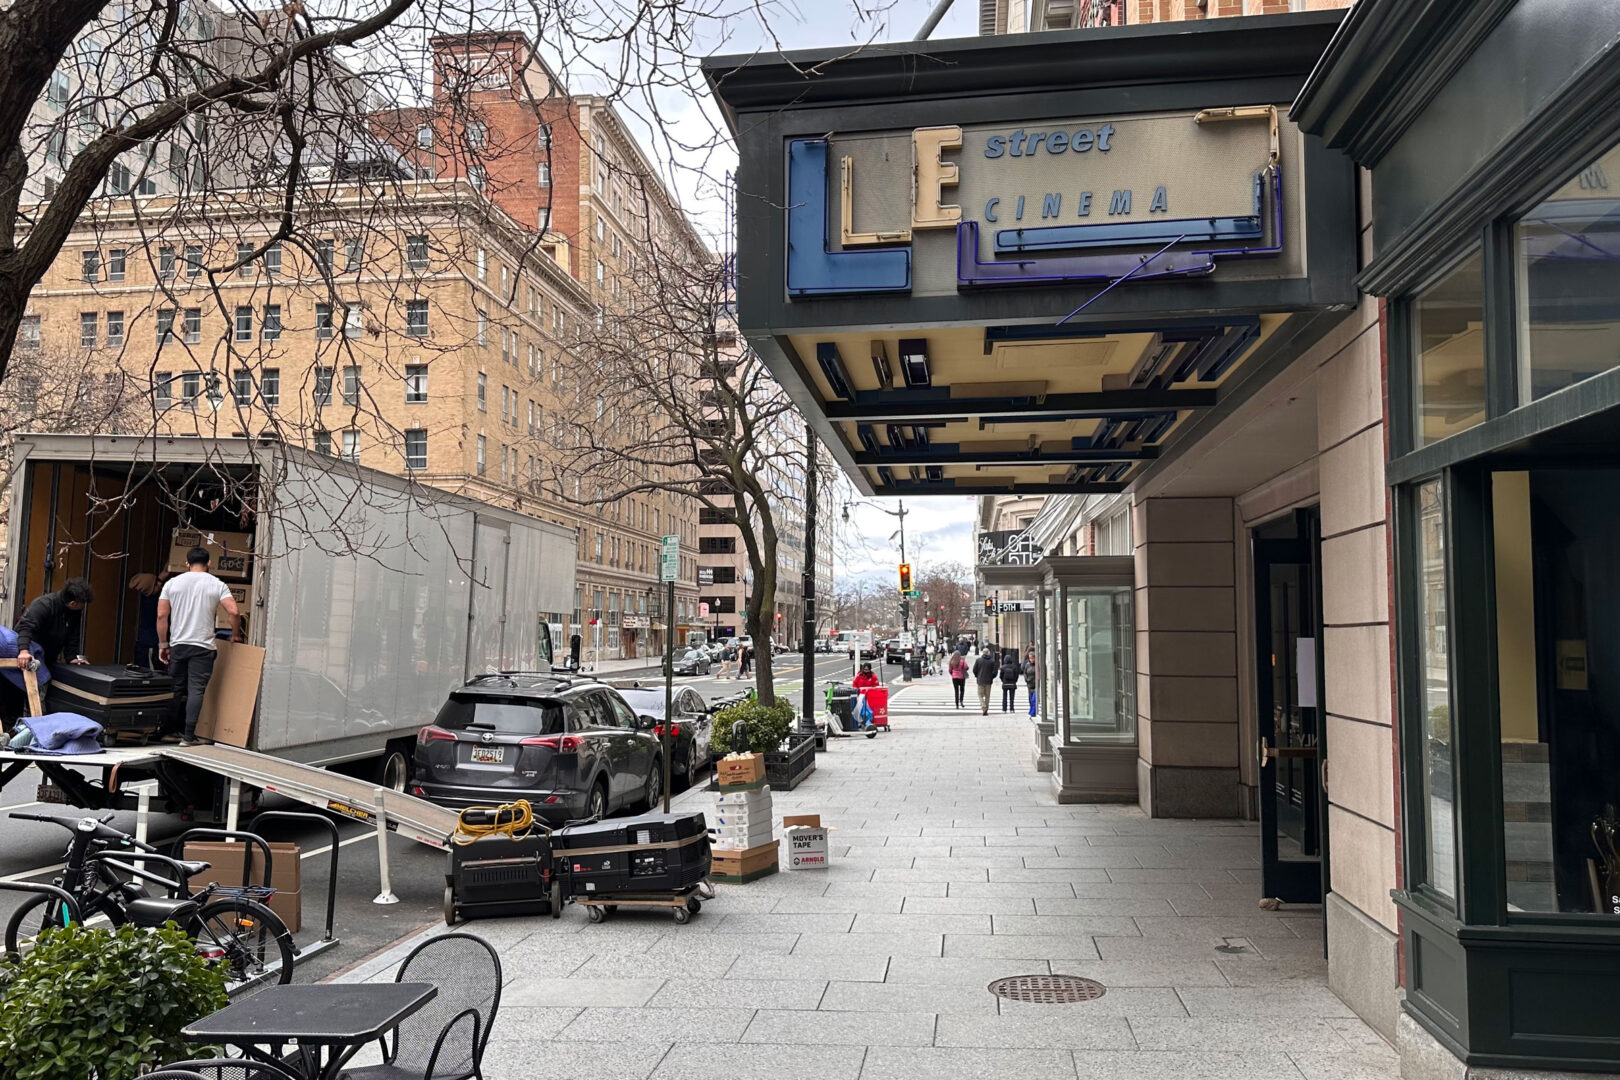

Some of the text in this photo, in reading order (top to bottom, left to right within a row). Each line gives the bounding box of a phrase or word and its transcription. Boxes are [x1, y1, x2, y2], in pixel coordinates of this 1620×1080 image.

[984, 123, 1115, 158] street
[985, 186, 1168, 222] CINEMA
[792, 834, 824, 842] MOVER'S
[793, 841, 812, 849] TAPE
